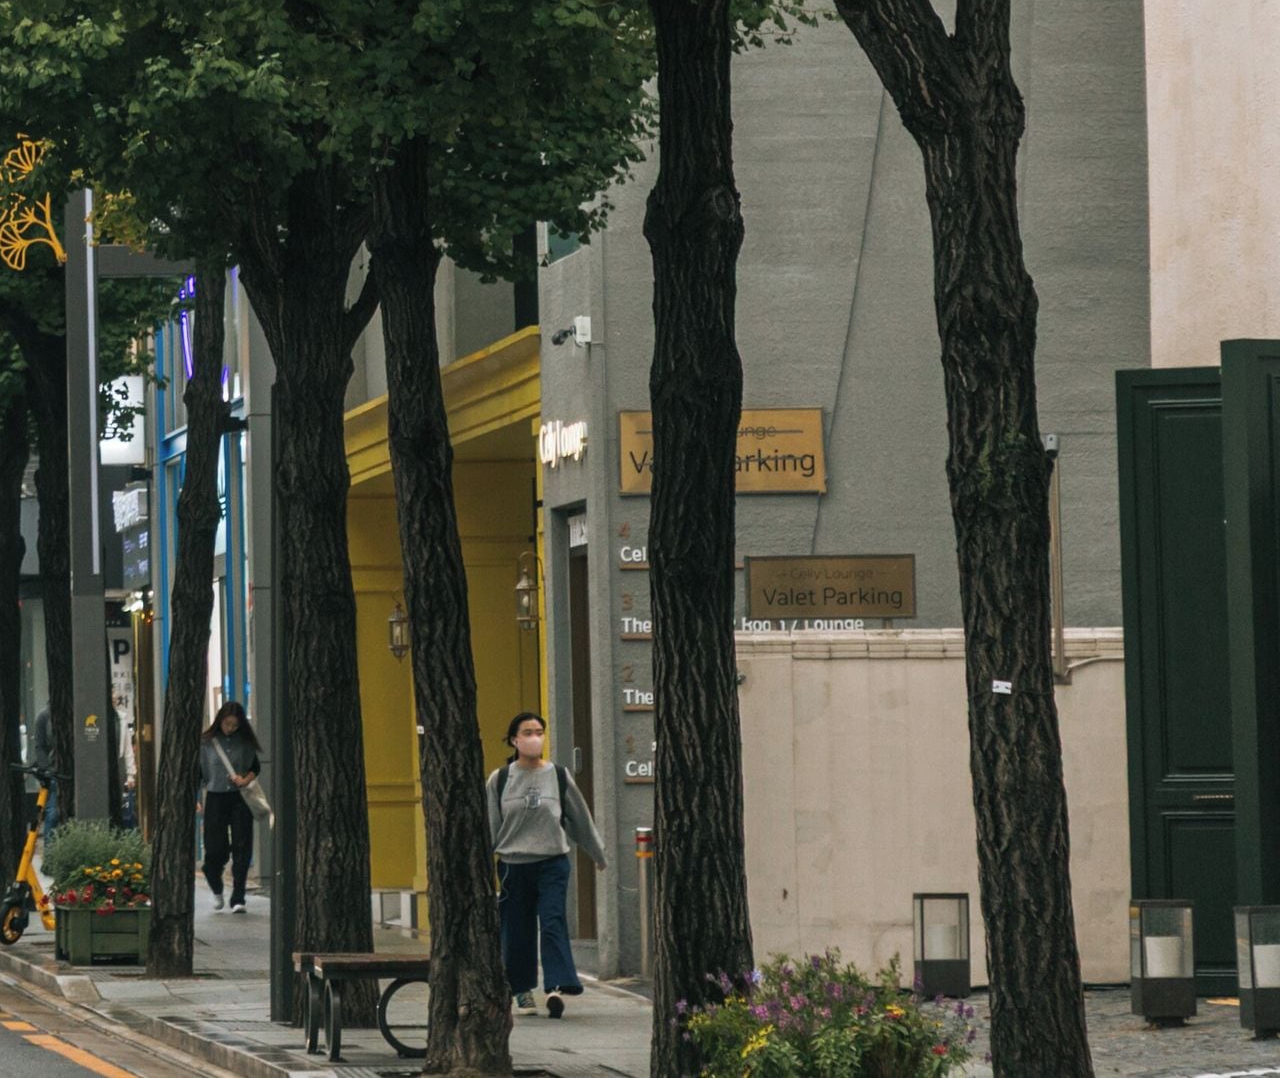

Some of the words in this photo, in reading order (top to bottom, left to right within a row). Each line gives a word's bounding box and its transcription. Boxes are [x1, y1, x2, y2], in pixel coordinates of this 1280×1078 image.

[762, 587, 816, 607] Valet
[824, 586, 903, 610] Parking
[621, 617, 652, 633] The
[113, 639, 131, 664] P
[623, 689, 654, 705] The
